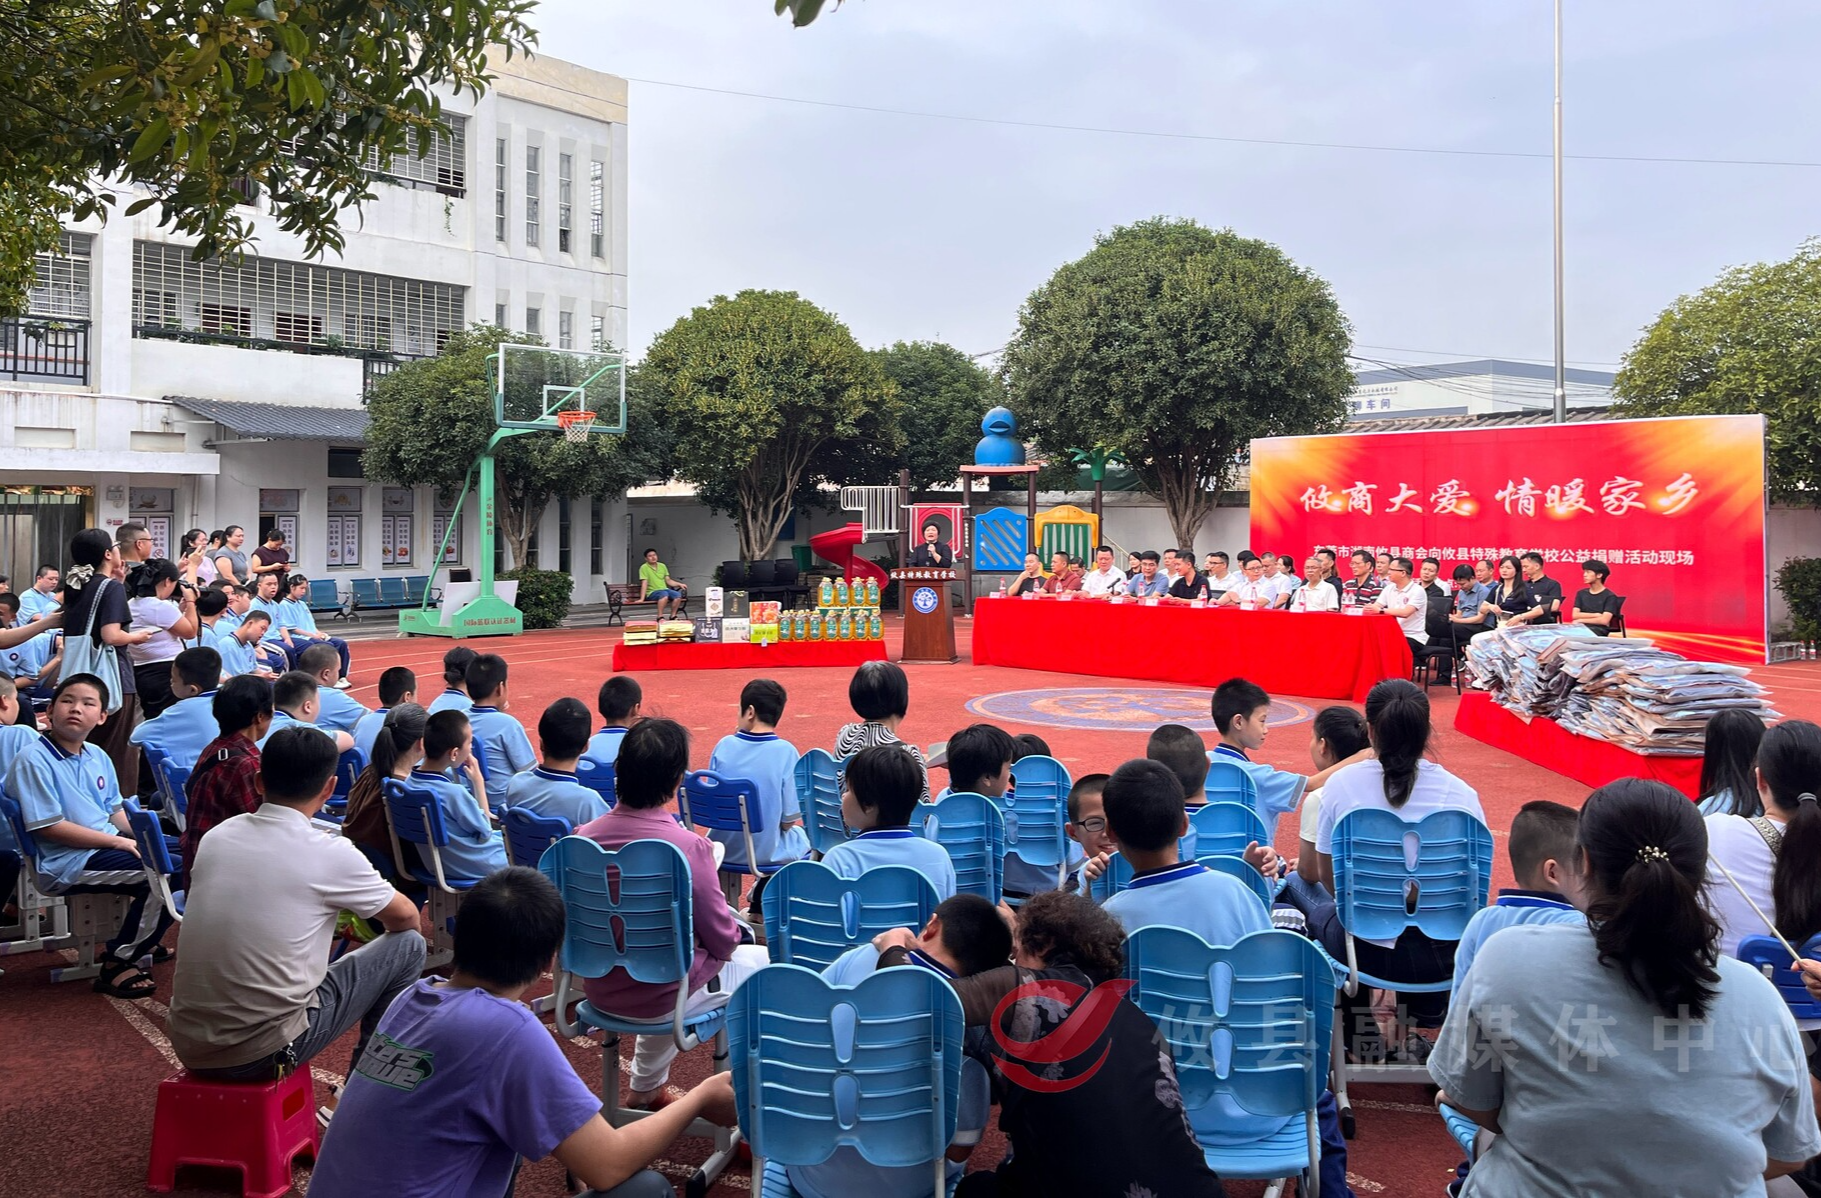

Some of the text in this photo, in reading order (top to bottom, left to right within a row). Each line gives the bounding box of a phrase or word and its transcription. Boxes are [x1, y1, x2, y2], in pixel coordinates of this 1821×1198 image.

[1300, 473, 1698, 517] 攸商大爱 情暖家乡
